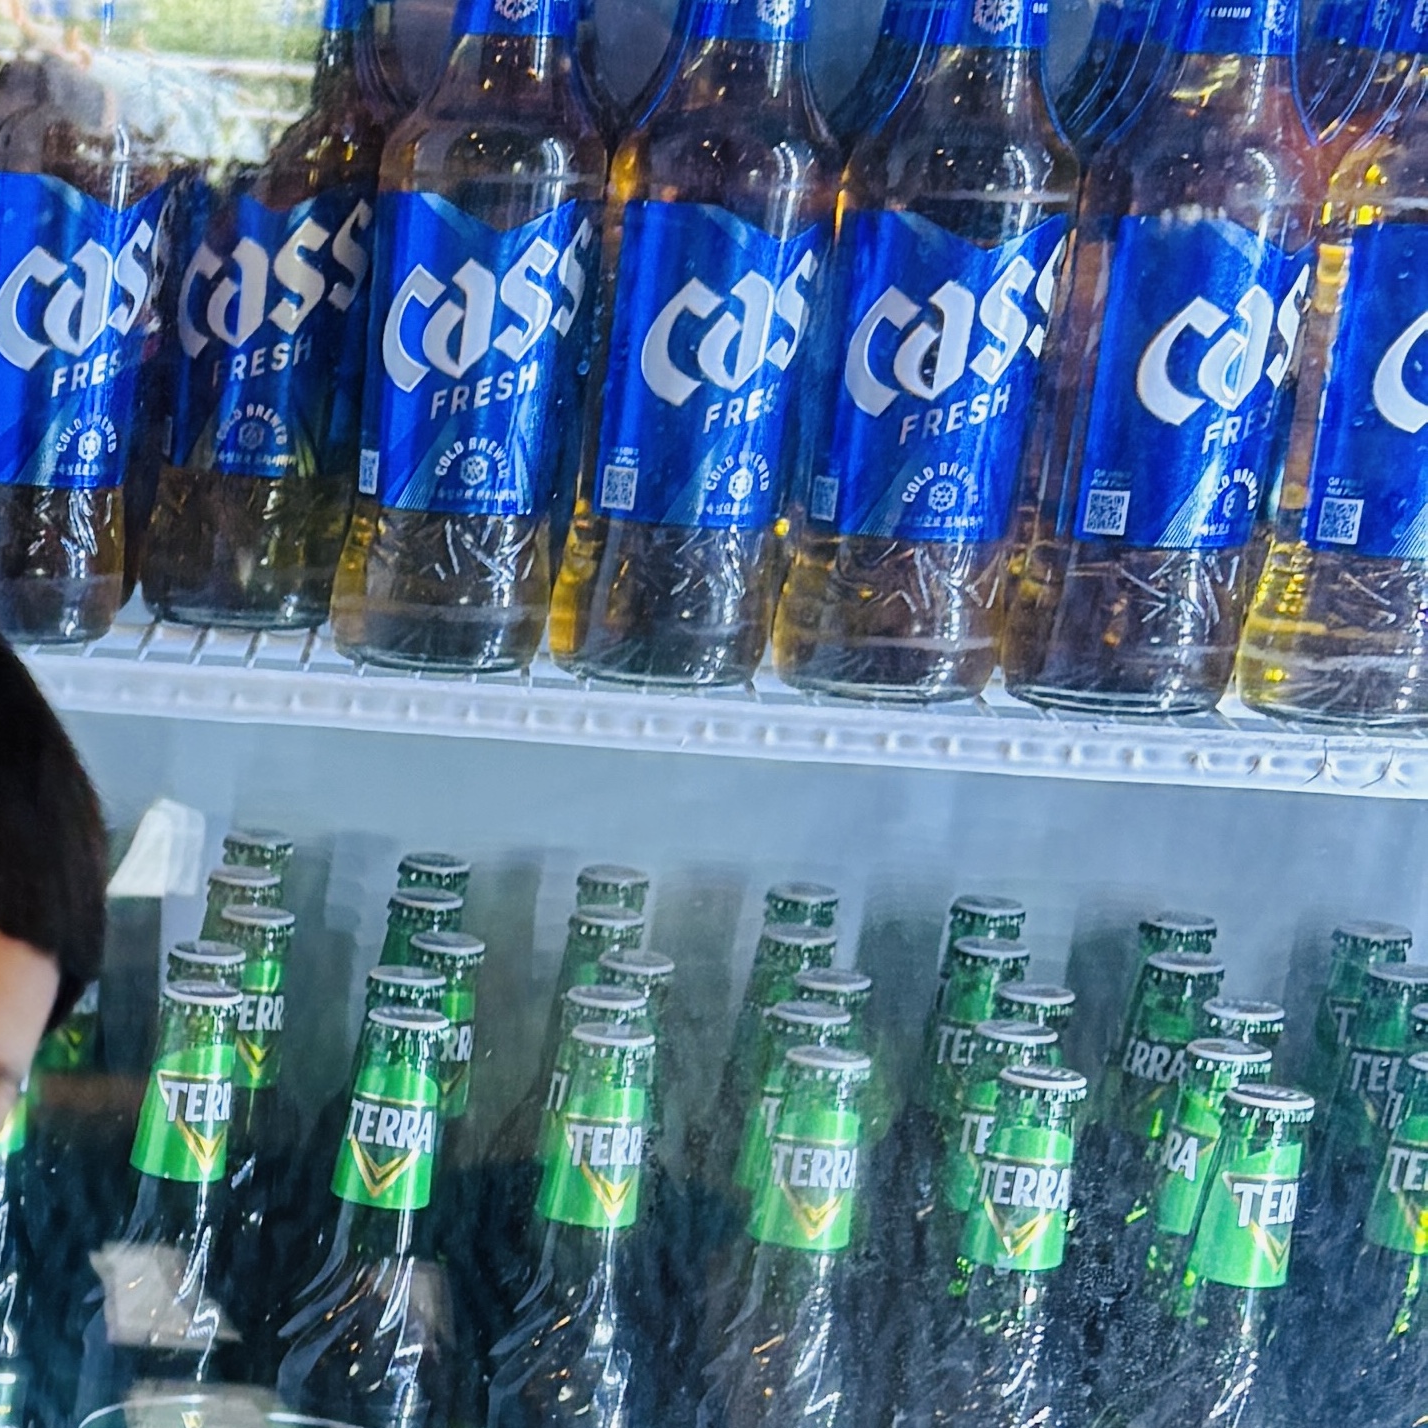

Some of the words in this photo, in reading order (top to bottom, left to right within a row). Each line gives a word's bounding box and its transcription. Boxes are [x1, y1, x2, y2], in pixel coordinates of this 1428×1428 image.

[383, 217, 594, 394] Cass
[641, 248, 818, 407] Cas
[1136, 262, 1313, 427] Cas
[429, 360, 539, 421] FRESH
[898, 382, 1012, 446] FRESH
[434, 440, 465, 477] COLD
[901, 466, 935, 504] COLD
[163, 1078, 233, 1123] TERR
[347, 1098, 437, 1154] TERRA
[569, 1123, 644, 1167] TERR
[978, 1160, 1072, 1211] TERRA
